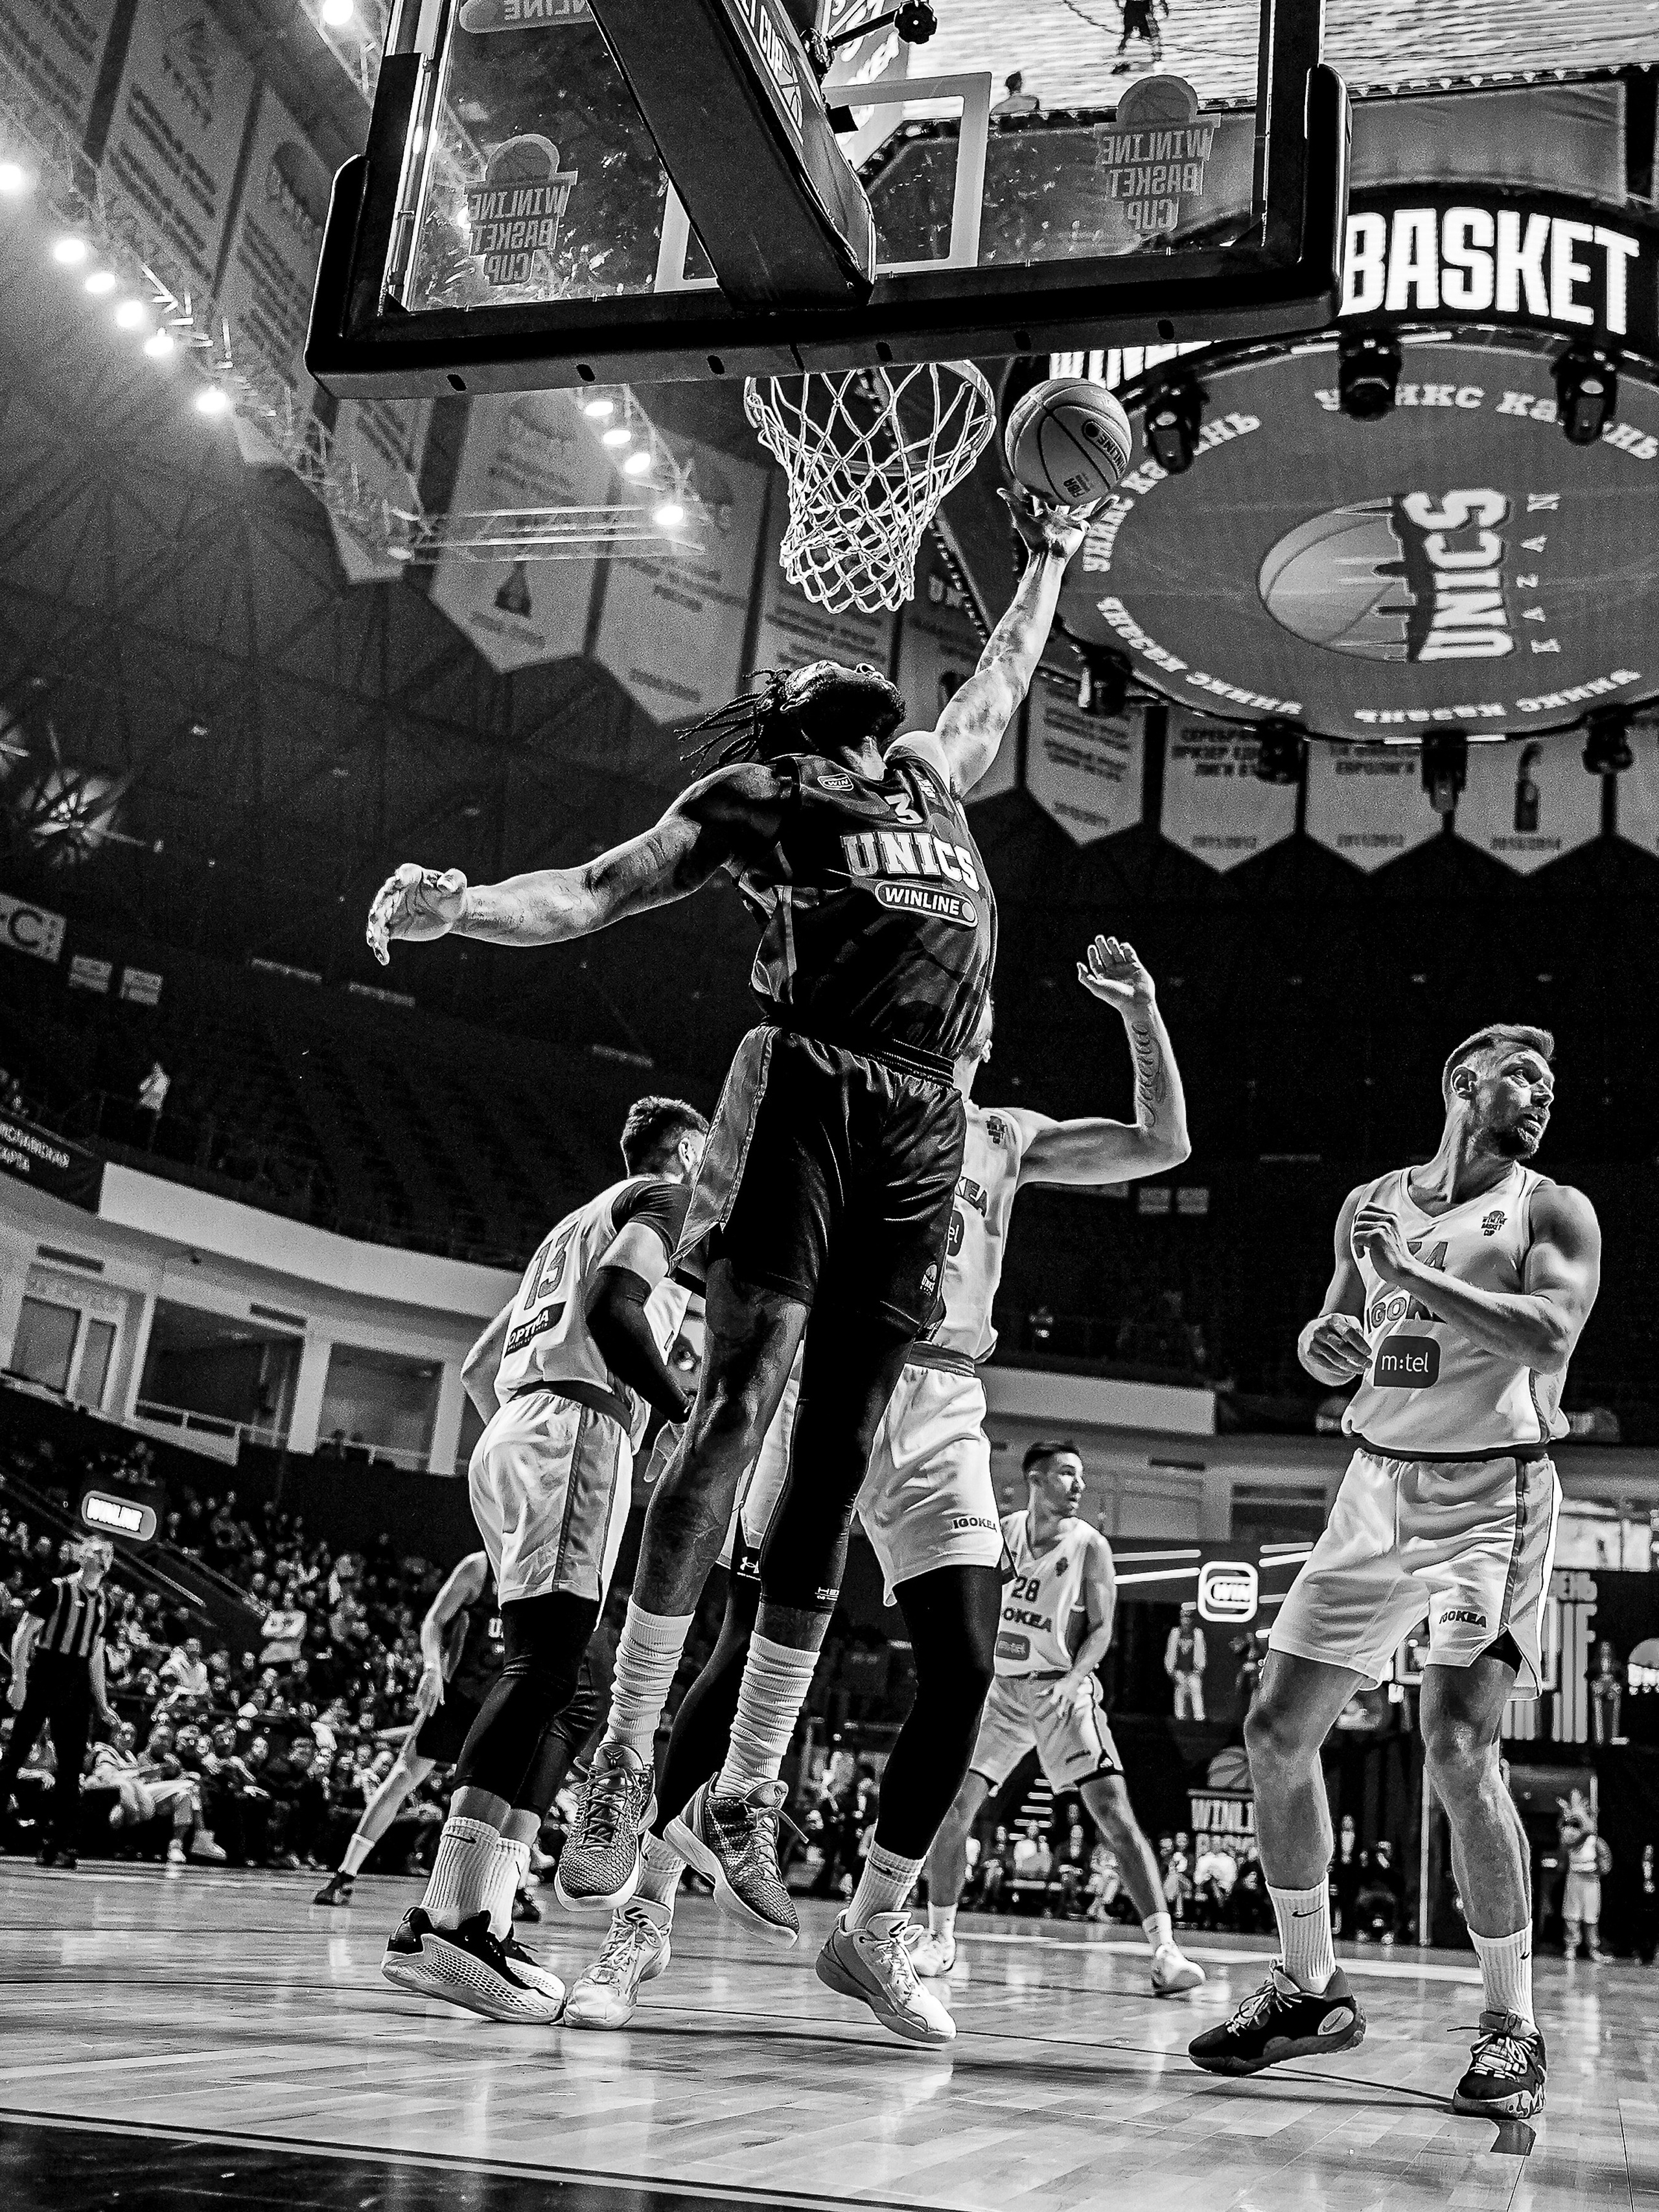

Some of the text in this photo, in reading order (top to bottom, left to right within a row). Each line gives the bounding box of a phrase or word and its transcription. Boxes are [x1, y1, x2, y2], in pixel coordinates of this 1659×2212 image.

[1338, 207, 1640, 334] BASKET
[1402, 488, 1514, 662] UNICS
[828, 778, 849, 787] WIN
[884, 792, 925, 825] 3
[840, 832, 980, 892] UNICS
[885, 887, 960, 916] WINLINE
[524, 1220, 579, 1310] 13
[1381, 1352, 1429, 1373] m:tel
[1011, 1576, 1041, 1603] 28
[1002, 1607, 1052, 1633] OKEA
